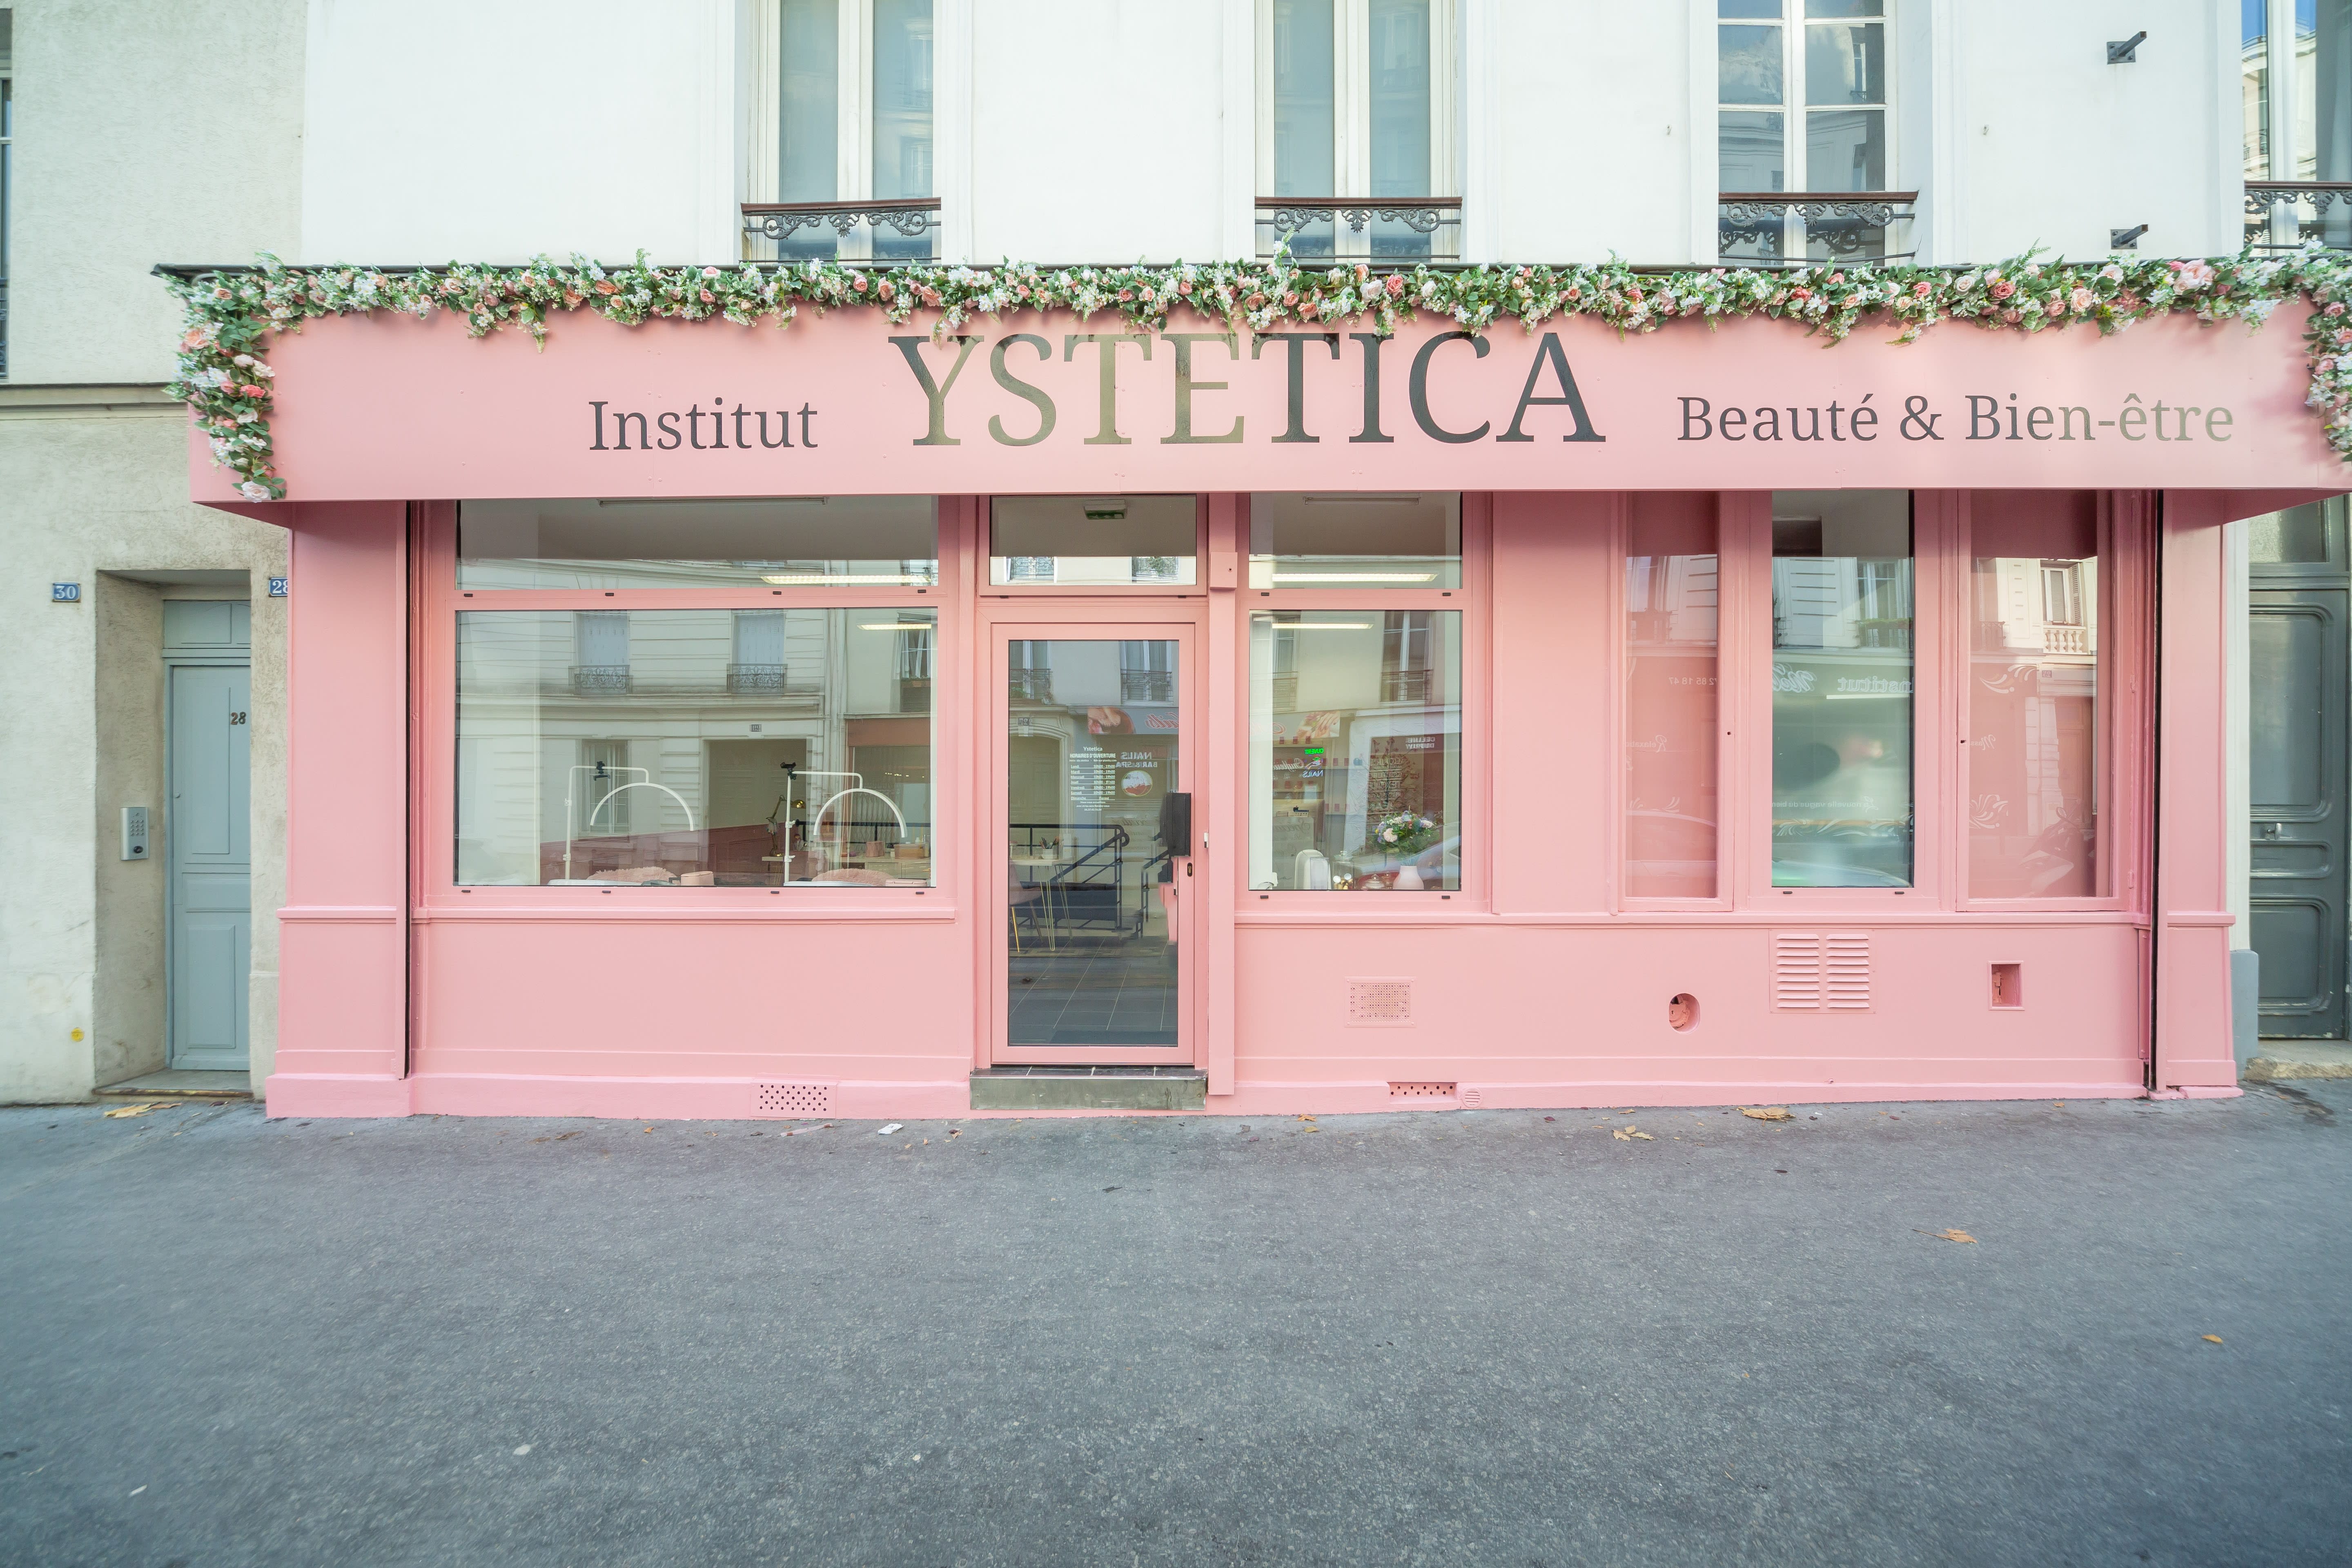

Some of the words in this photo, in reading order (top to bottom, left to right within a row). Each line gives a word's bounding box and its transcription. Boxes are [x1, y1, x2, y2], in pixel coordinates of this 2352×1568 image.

[589, 397, 817, 450] Institut
[888, 332, 1606, 447] YSTETICA
[1677, 393, 1878, 441] Beauté
[1900, 395, 1944, 441] &
[1965, 393, 2234, 442] Bien-être
[56, 585, 76, 599] 30
[231, 711, 246, 725] 28
